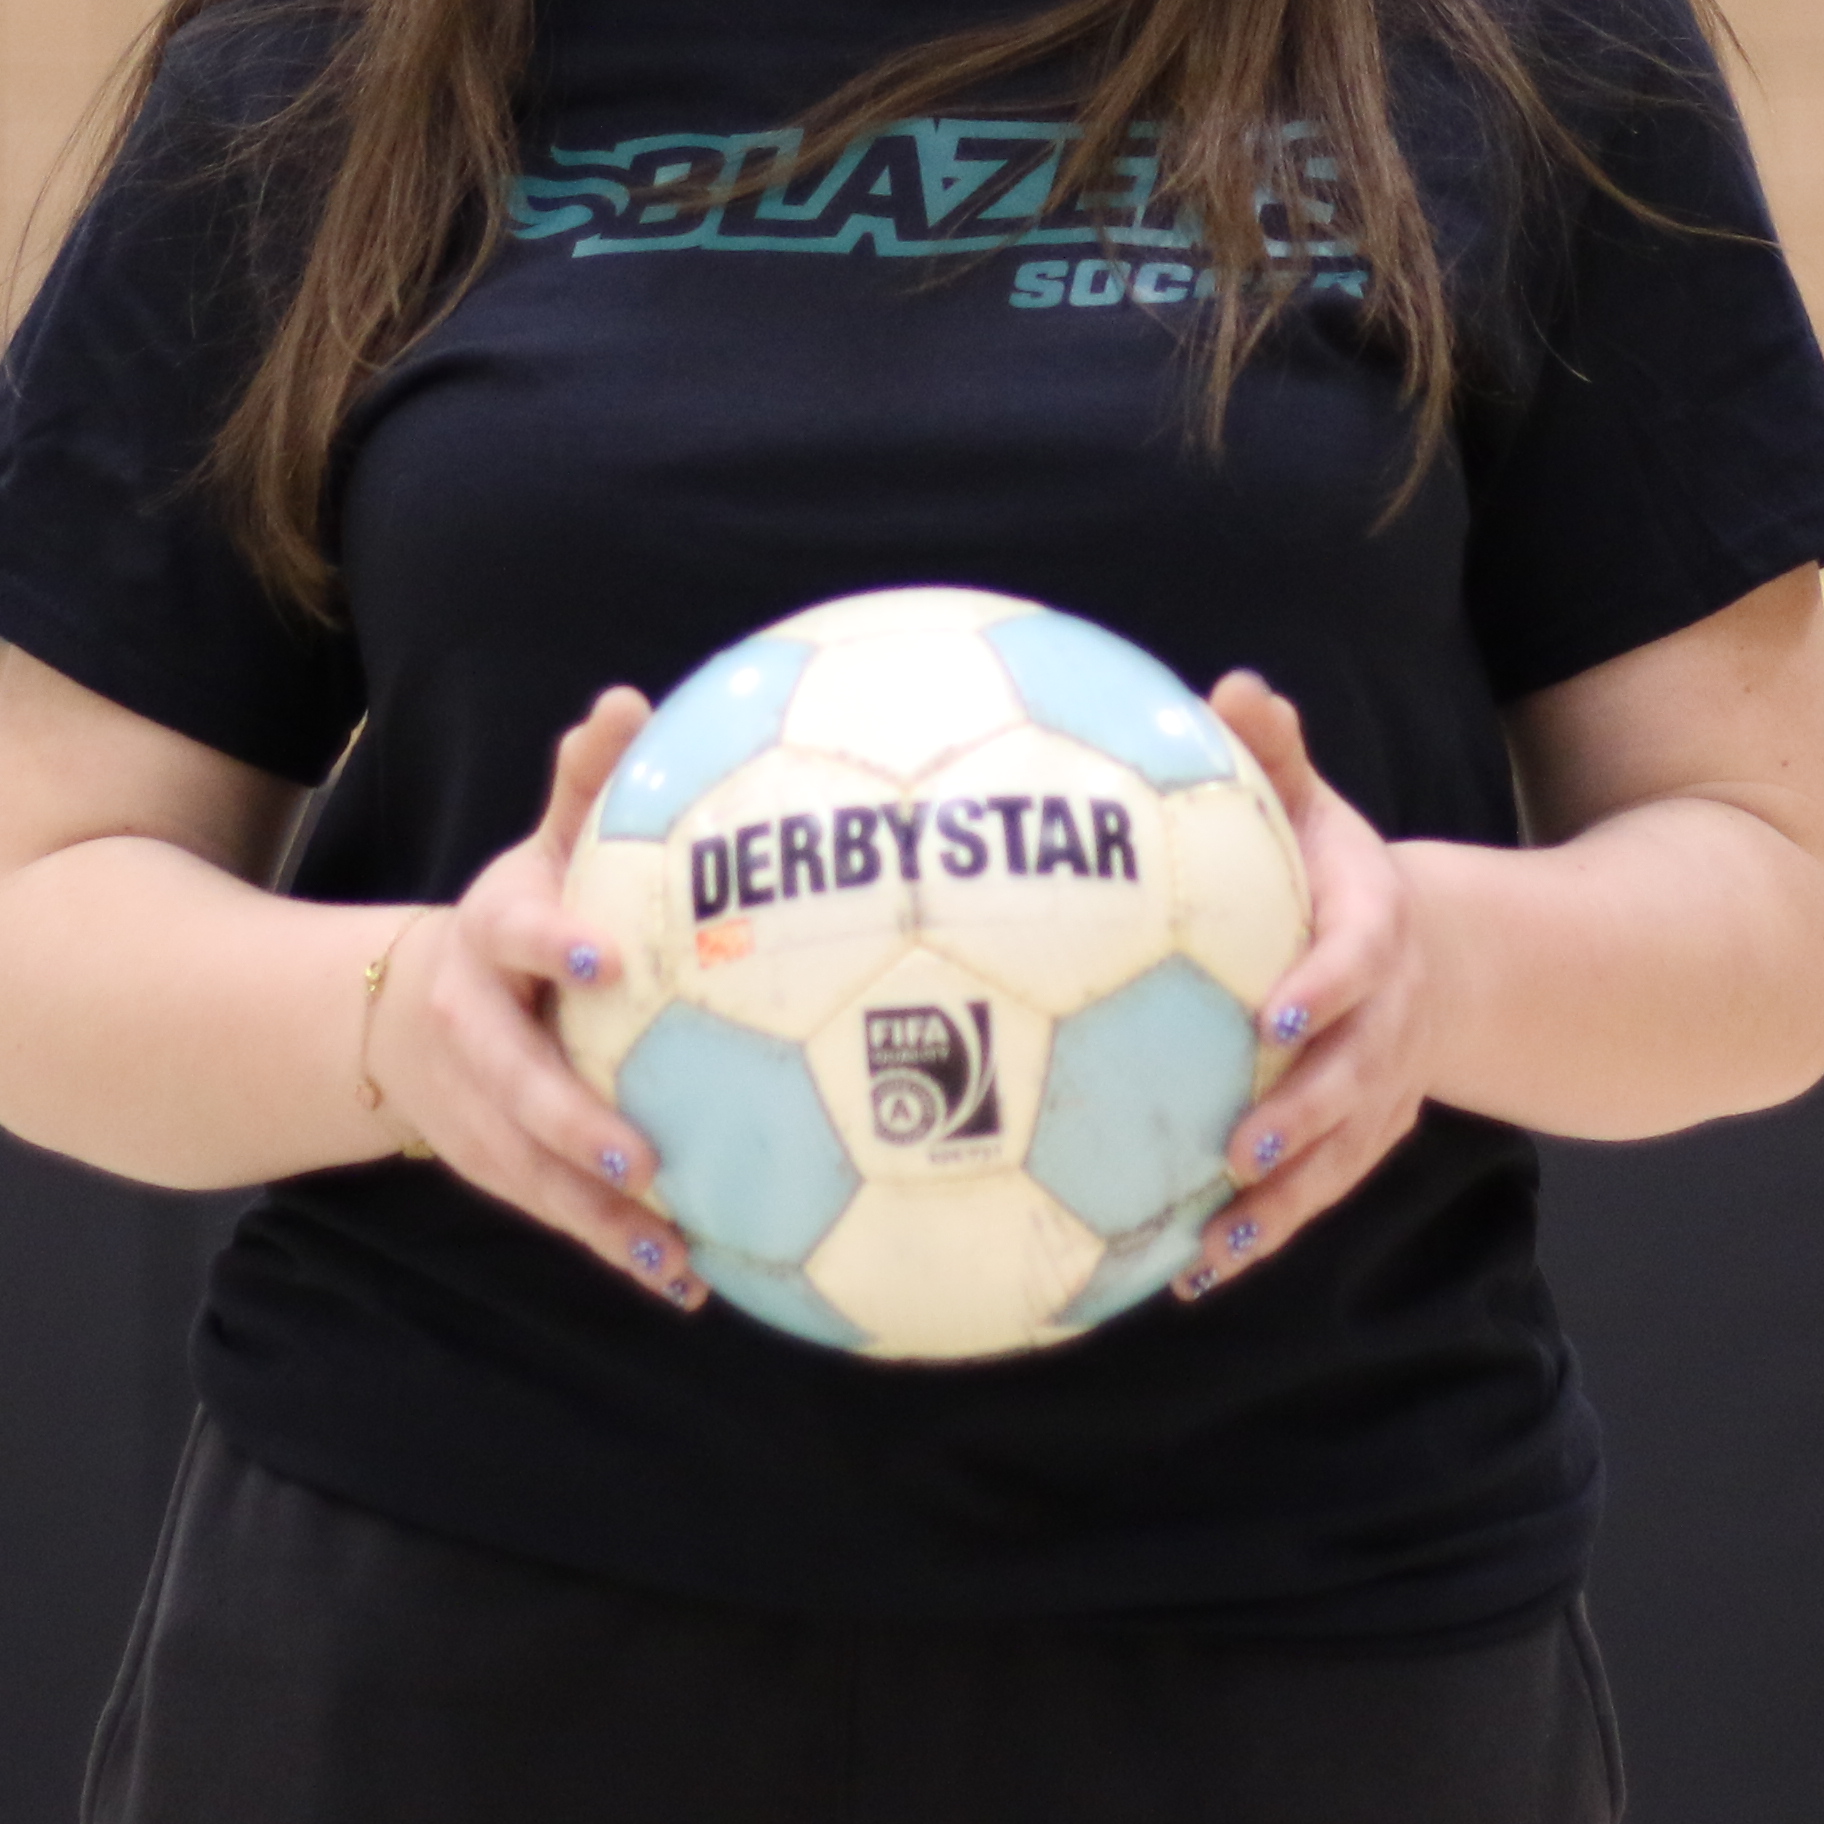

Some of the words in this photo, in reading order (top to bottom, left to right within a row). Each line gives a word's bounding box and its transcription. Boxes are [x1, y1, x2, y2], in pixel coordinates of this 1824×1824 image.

[526, 118, 1361, 256] BLAZES
[691, 795, 1139, 922] DERBYSTAR
[870, 1015, 951, 1047] FIFA
